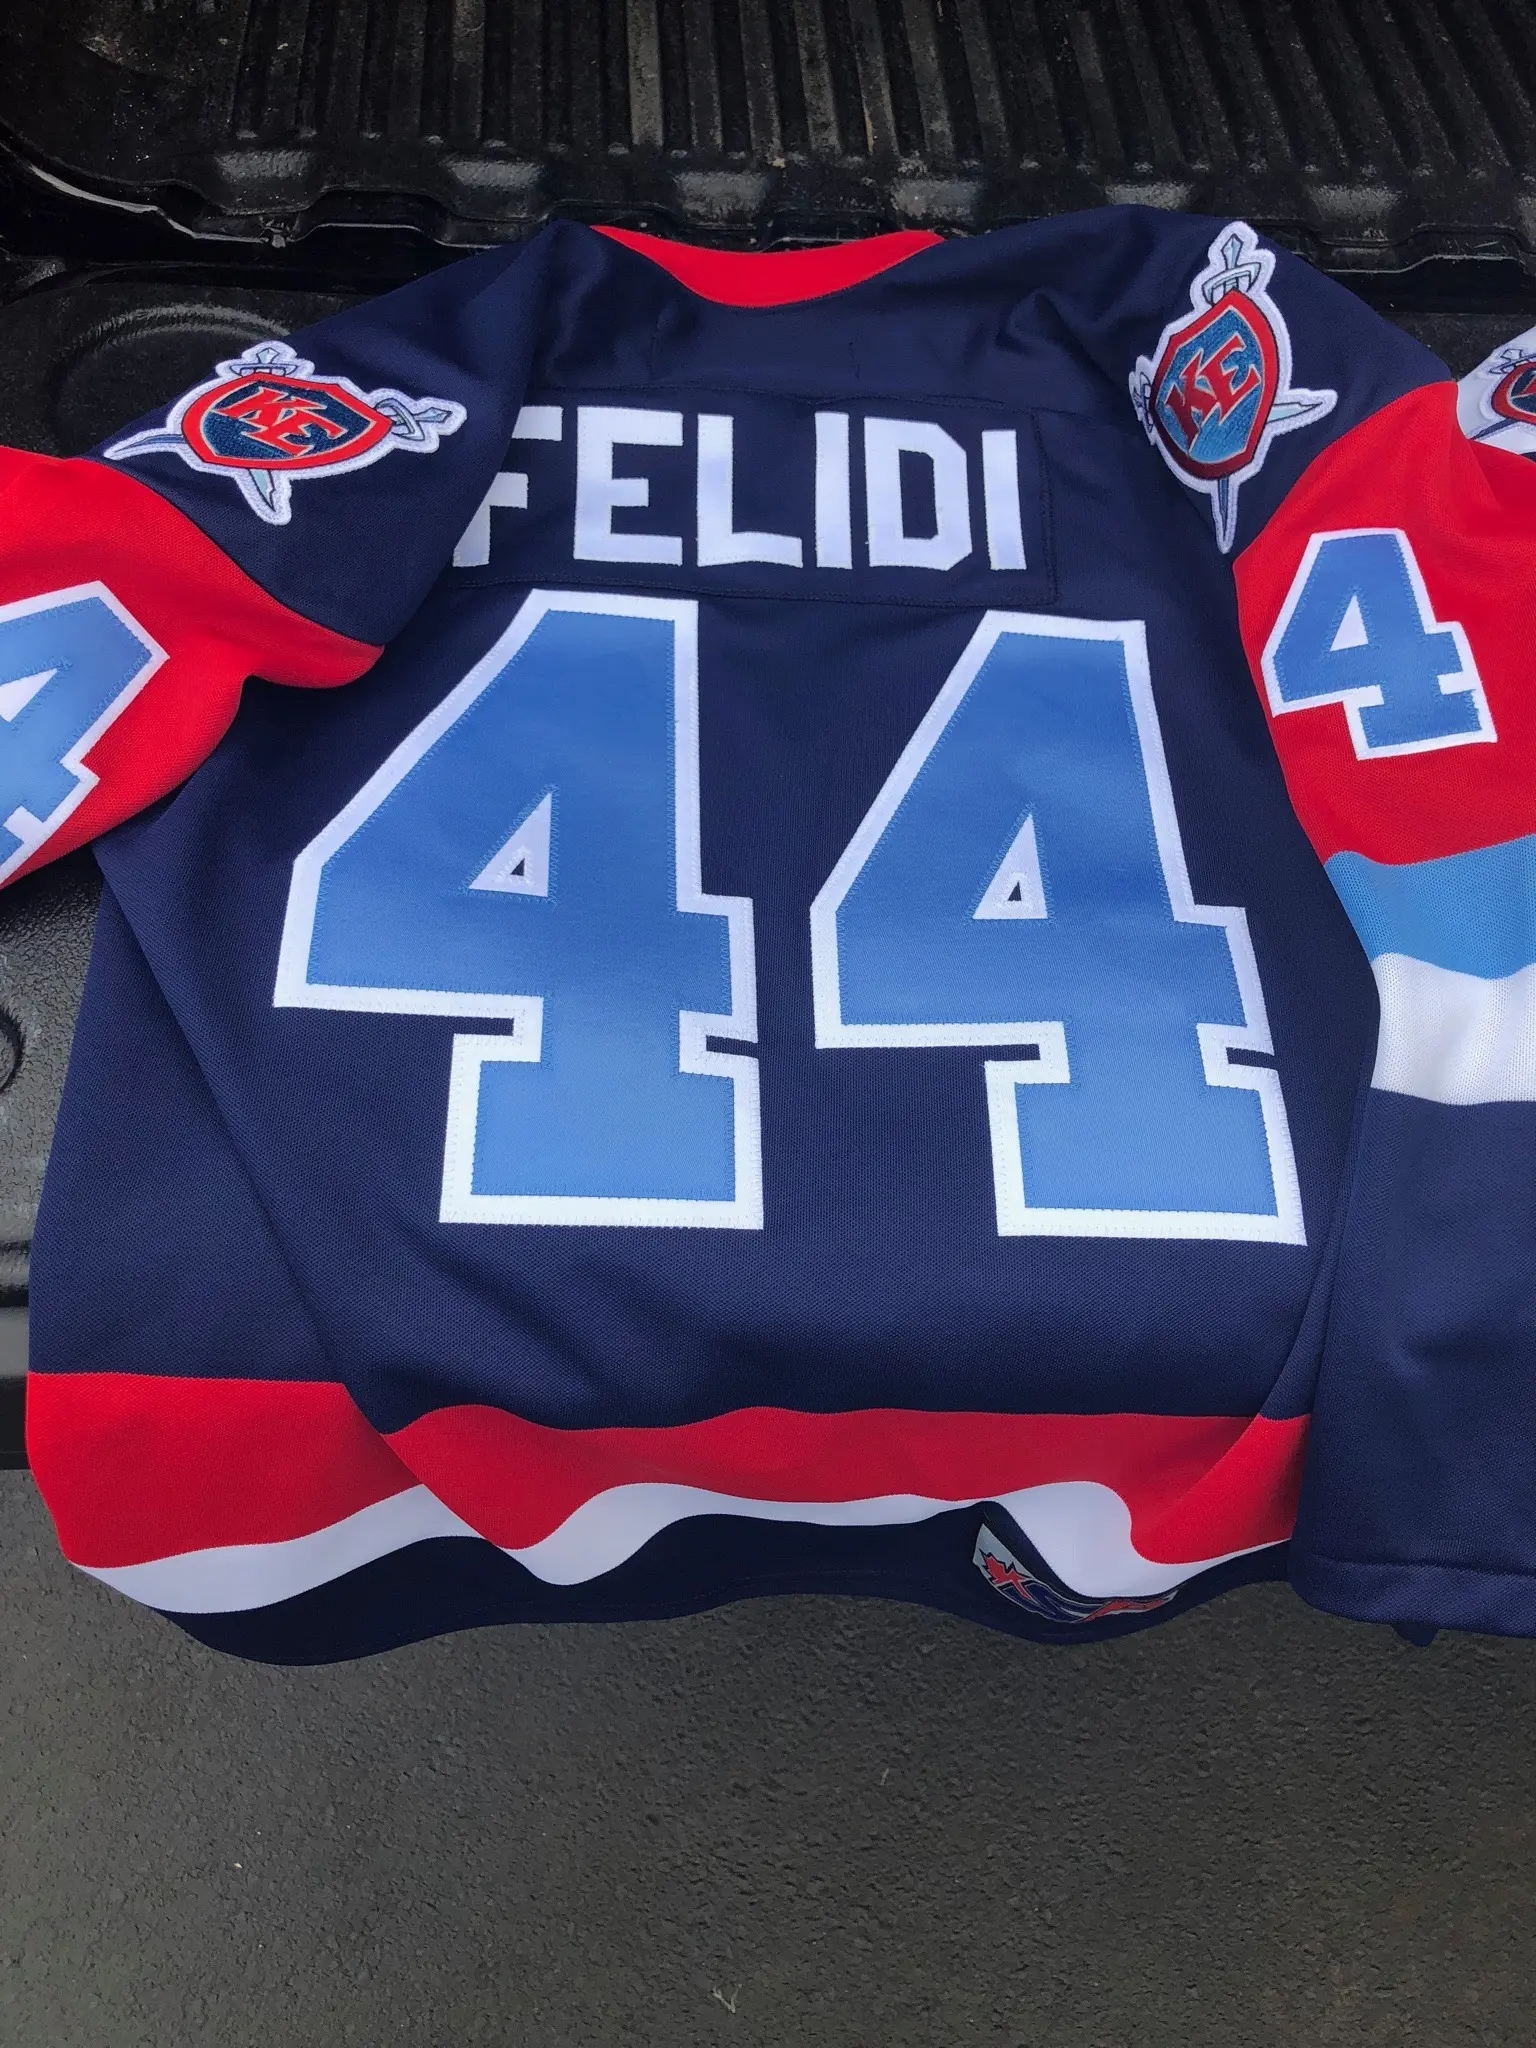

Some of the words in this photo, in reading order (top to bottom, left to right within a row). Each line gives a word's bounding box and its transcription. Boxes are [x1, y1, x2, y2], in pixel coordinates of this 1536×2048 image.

[453, 405, 1027, 571] FELIDI
[1164, 332, 1261, 453] KE
[1261, 528, 1497, 760] 4
[274, 589, 1306, 1245] 44
